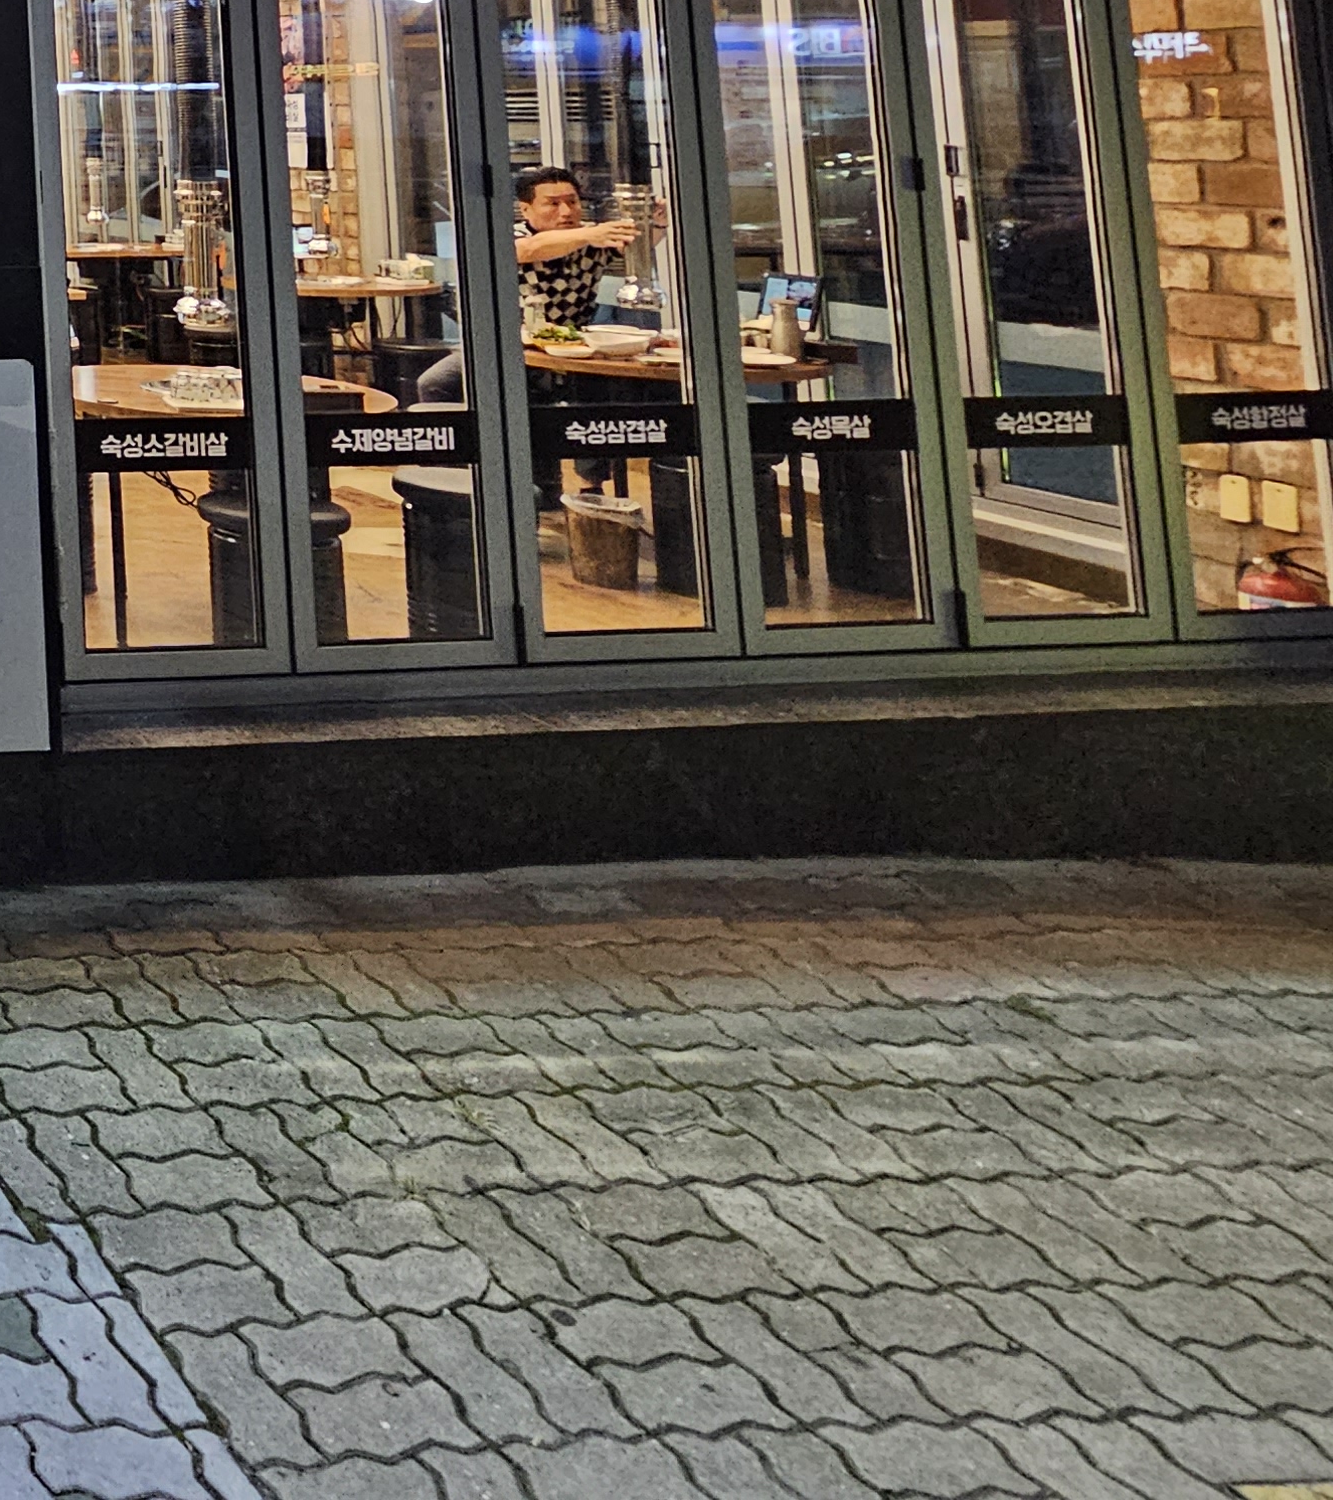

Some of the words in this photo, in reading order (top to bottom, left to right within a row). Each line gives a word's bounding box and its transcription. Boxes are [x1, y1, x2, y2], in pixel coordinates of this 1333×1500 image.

[564, 418, 668, 445] 숙성삼겹살
[791, 414, 872, 440] 숙성목살
[994, 409, 1094, 436] 숙성오겹살
[100, 431, 229, 459] 숙성소갈비살
[331, 426, 456, 454] 수제양념갈비
